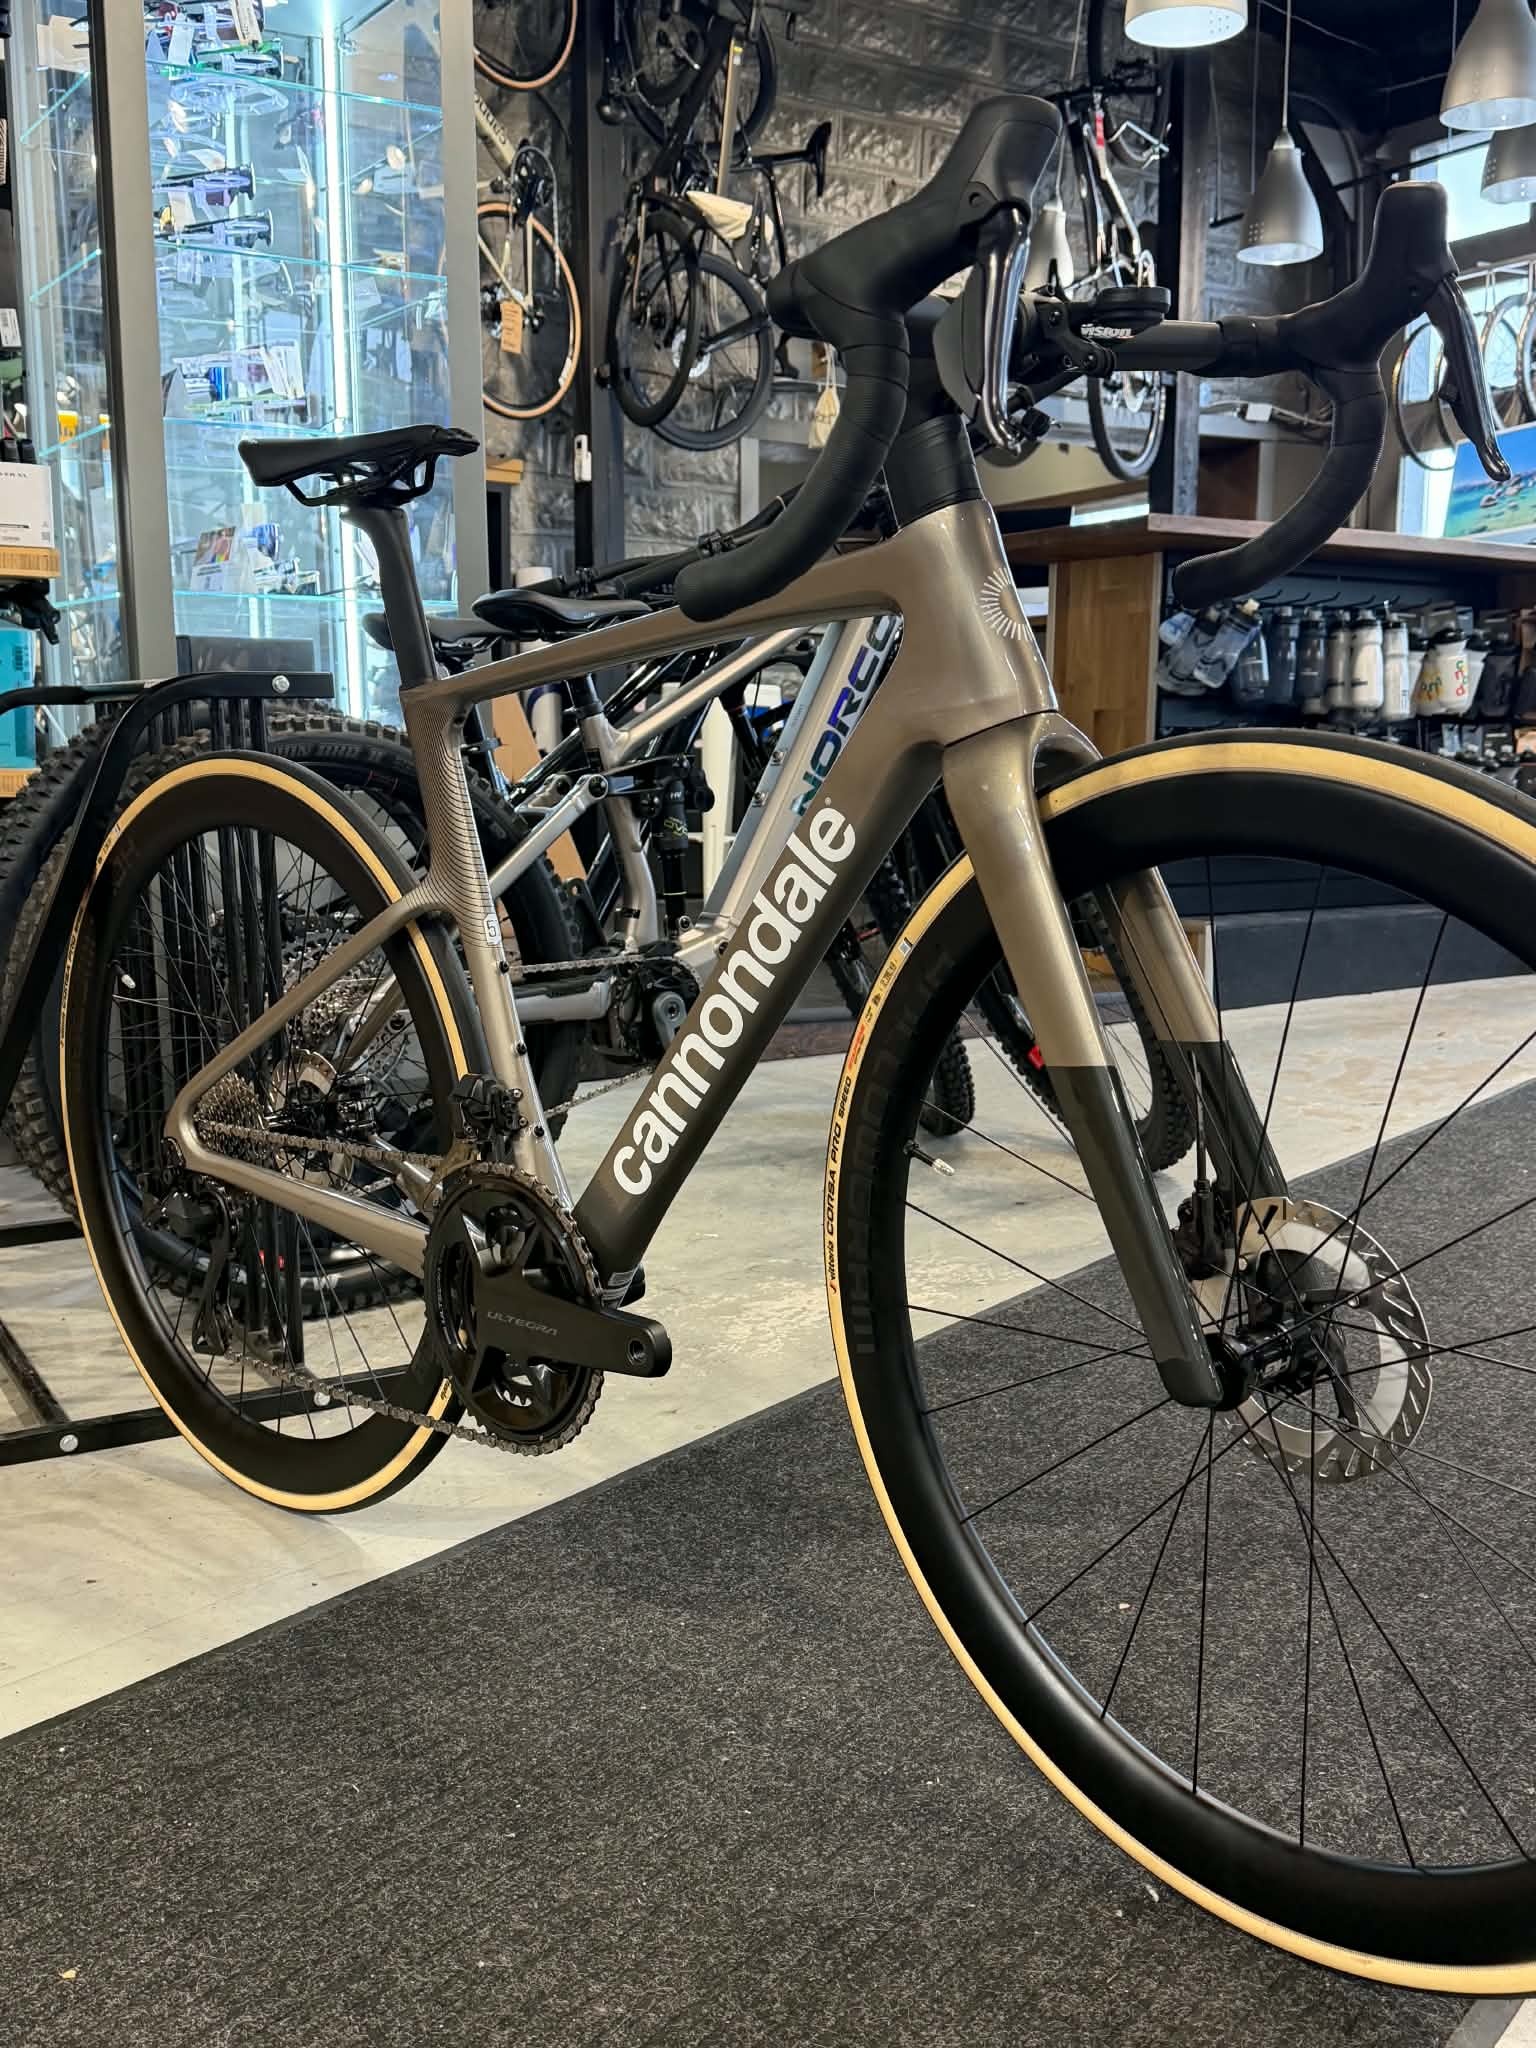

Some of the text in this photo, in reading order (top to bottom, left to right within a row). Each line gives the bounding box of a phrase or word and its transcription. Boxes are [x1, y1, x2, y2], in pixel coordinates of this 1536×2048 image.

[1080, 324, 1133, 338] vision
[790, 616, 898, 816] NORCO
[613, 805, 856, 1196] cannondale
[827, 1075, 852, 1281] vittoria CORSA PRO SPEED
[487, 1311, 559, 1336] ULTEGRA
